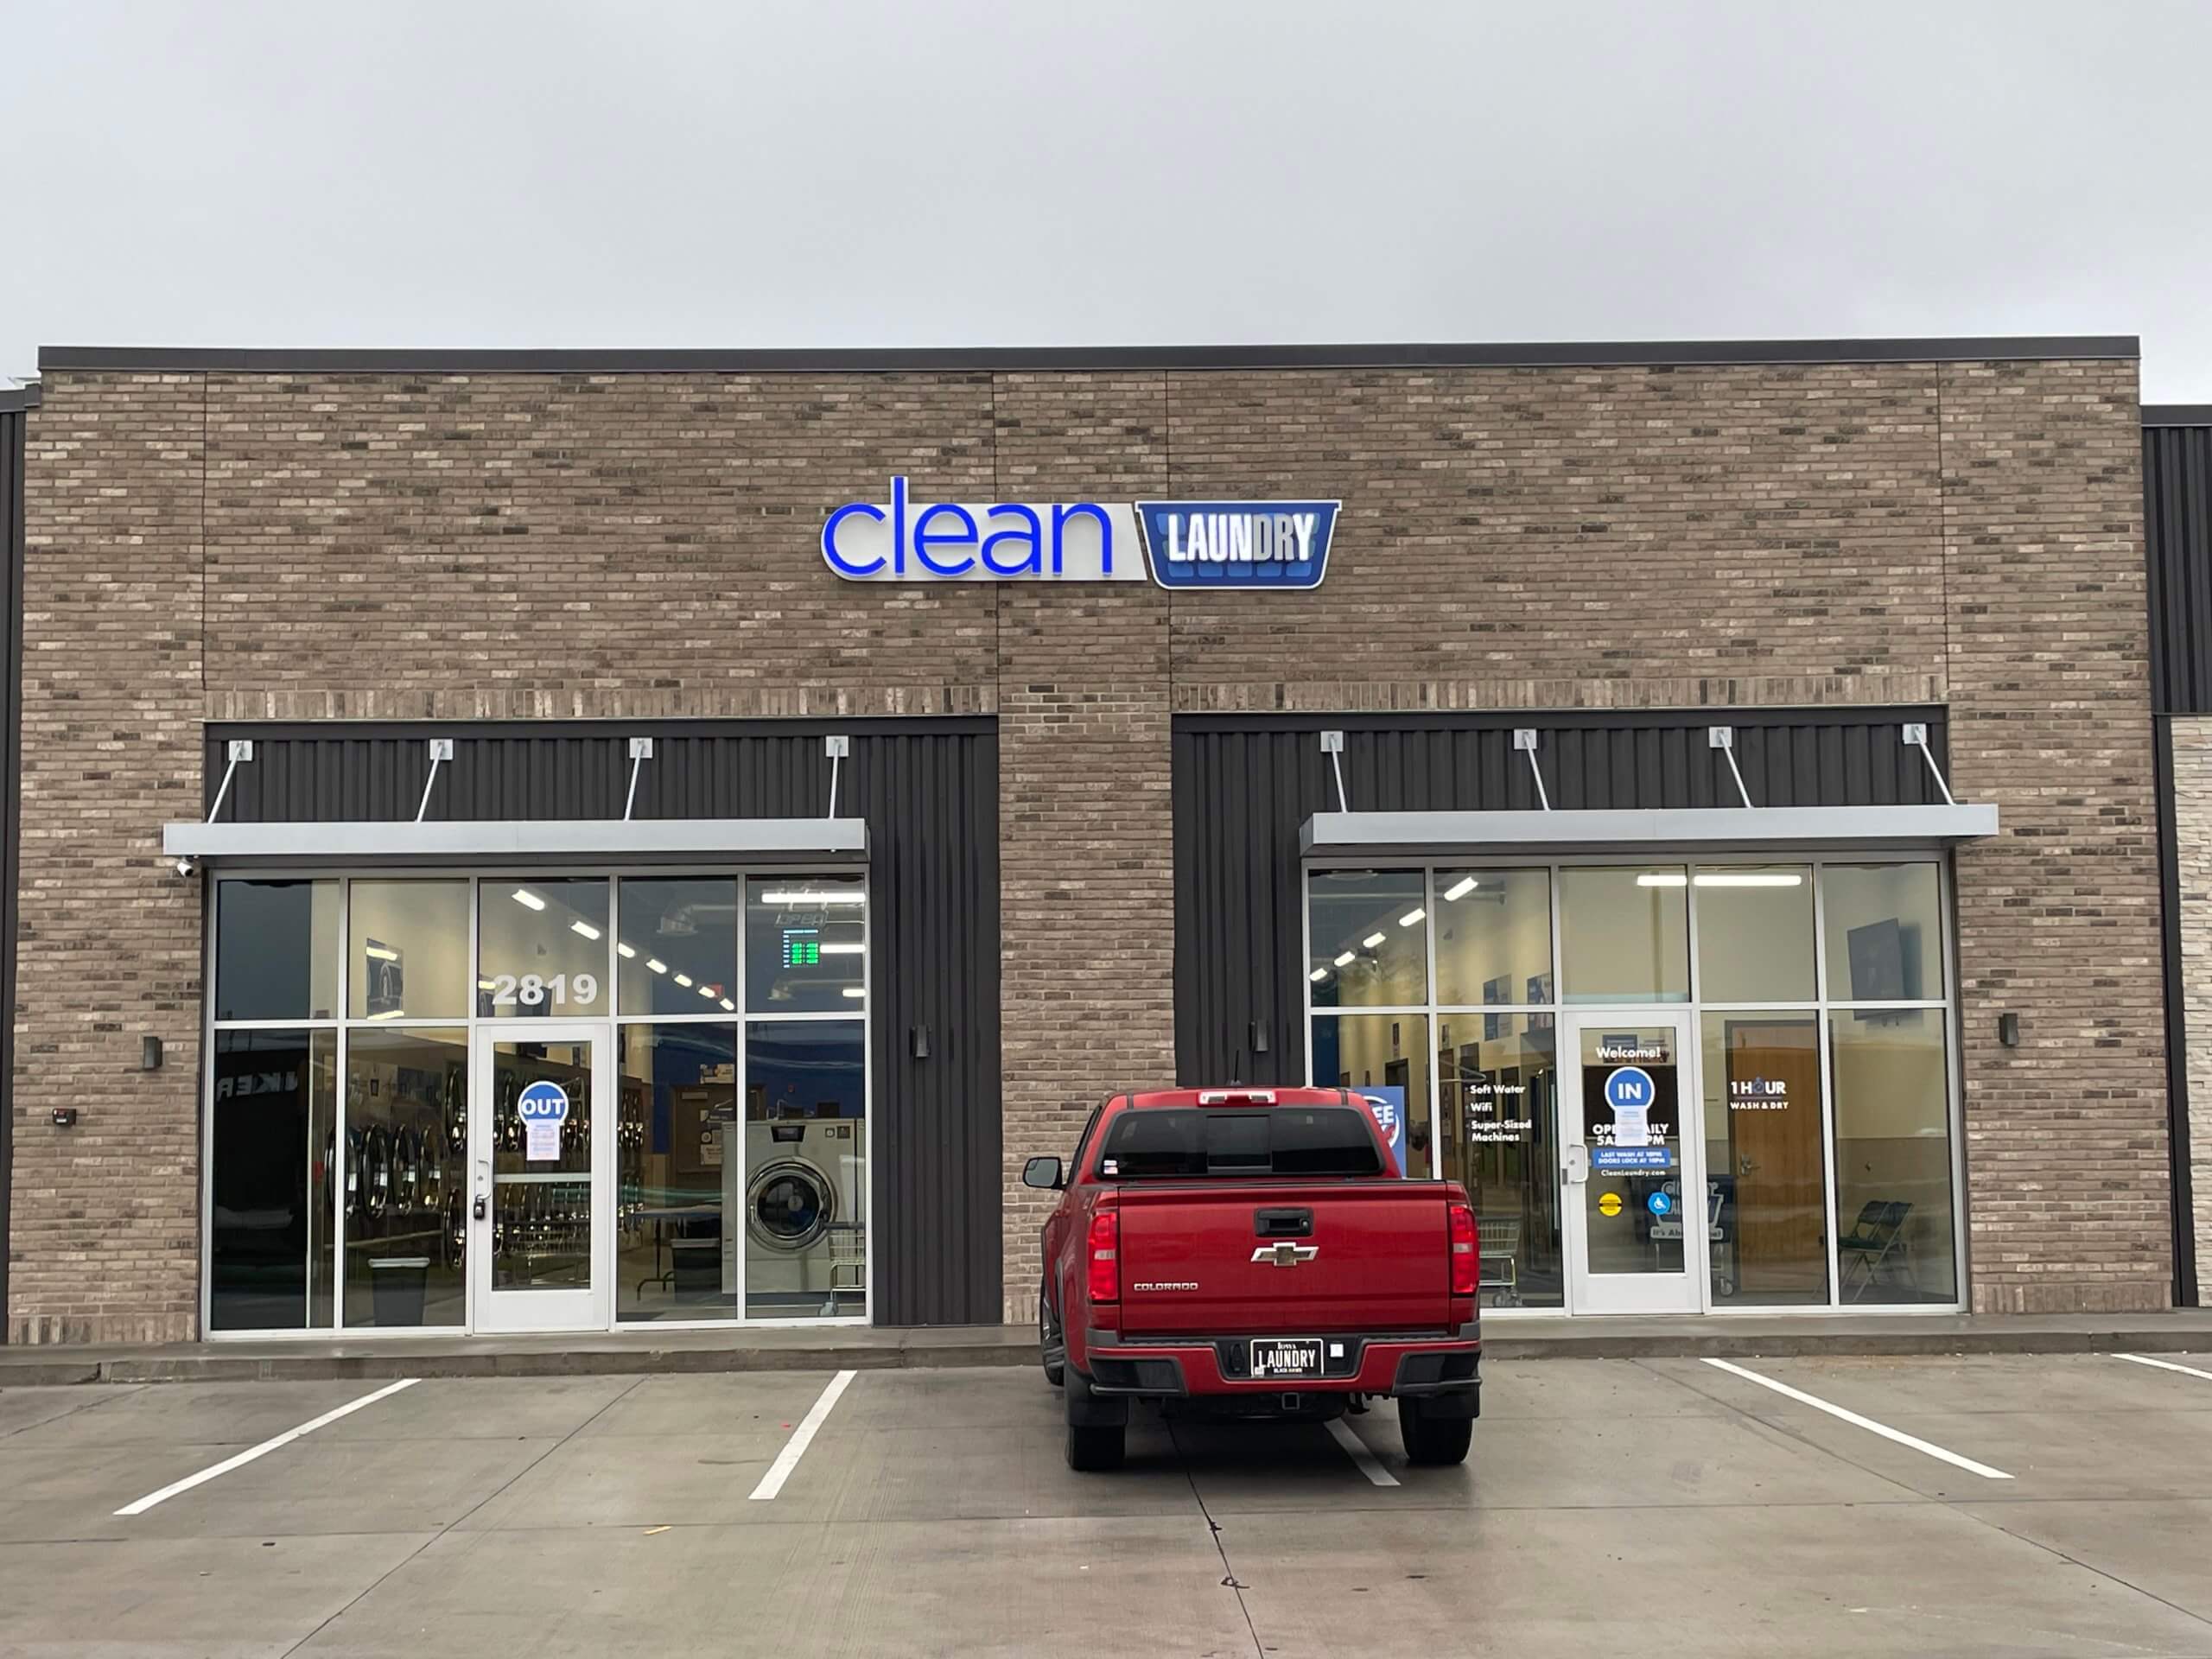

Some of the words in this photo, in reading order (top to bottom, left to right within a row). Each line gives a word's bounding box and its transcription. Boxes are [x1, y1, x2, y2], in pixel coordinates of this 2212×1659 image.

[821, 476, 1113, 575] clean
[1168, 513, 1314, 562] LAUNDRY
[492, 974, 598, 1005] 2819
[1595, 1046, 1661, 1058] Welcome!
[1470, 1084, 1491, 1095] Soft
[1492, 1084, 1527, 1095] Water
[1618, 1083, 1642, 1100] IN
[1731, 1081, 1738, 1095] 1
[521, 1098, 564, 1116] OUT
[1471, 1102, 1493, 1112] Wifi
[1371, 1104, 1395, 1124] EE
[1471, 1119, 1533, 1132] Super-Sized
[1592, 1123, 1617, 1135] OPE
[1471, 1132, 1521, 1141] Machines
[1596, 1135, 1616, 1147] 5A
[1134, 1282, 1198, 1291] COLORADO
[1258, 1350, 1316, 1368] LAUNDRY
